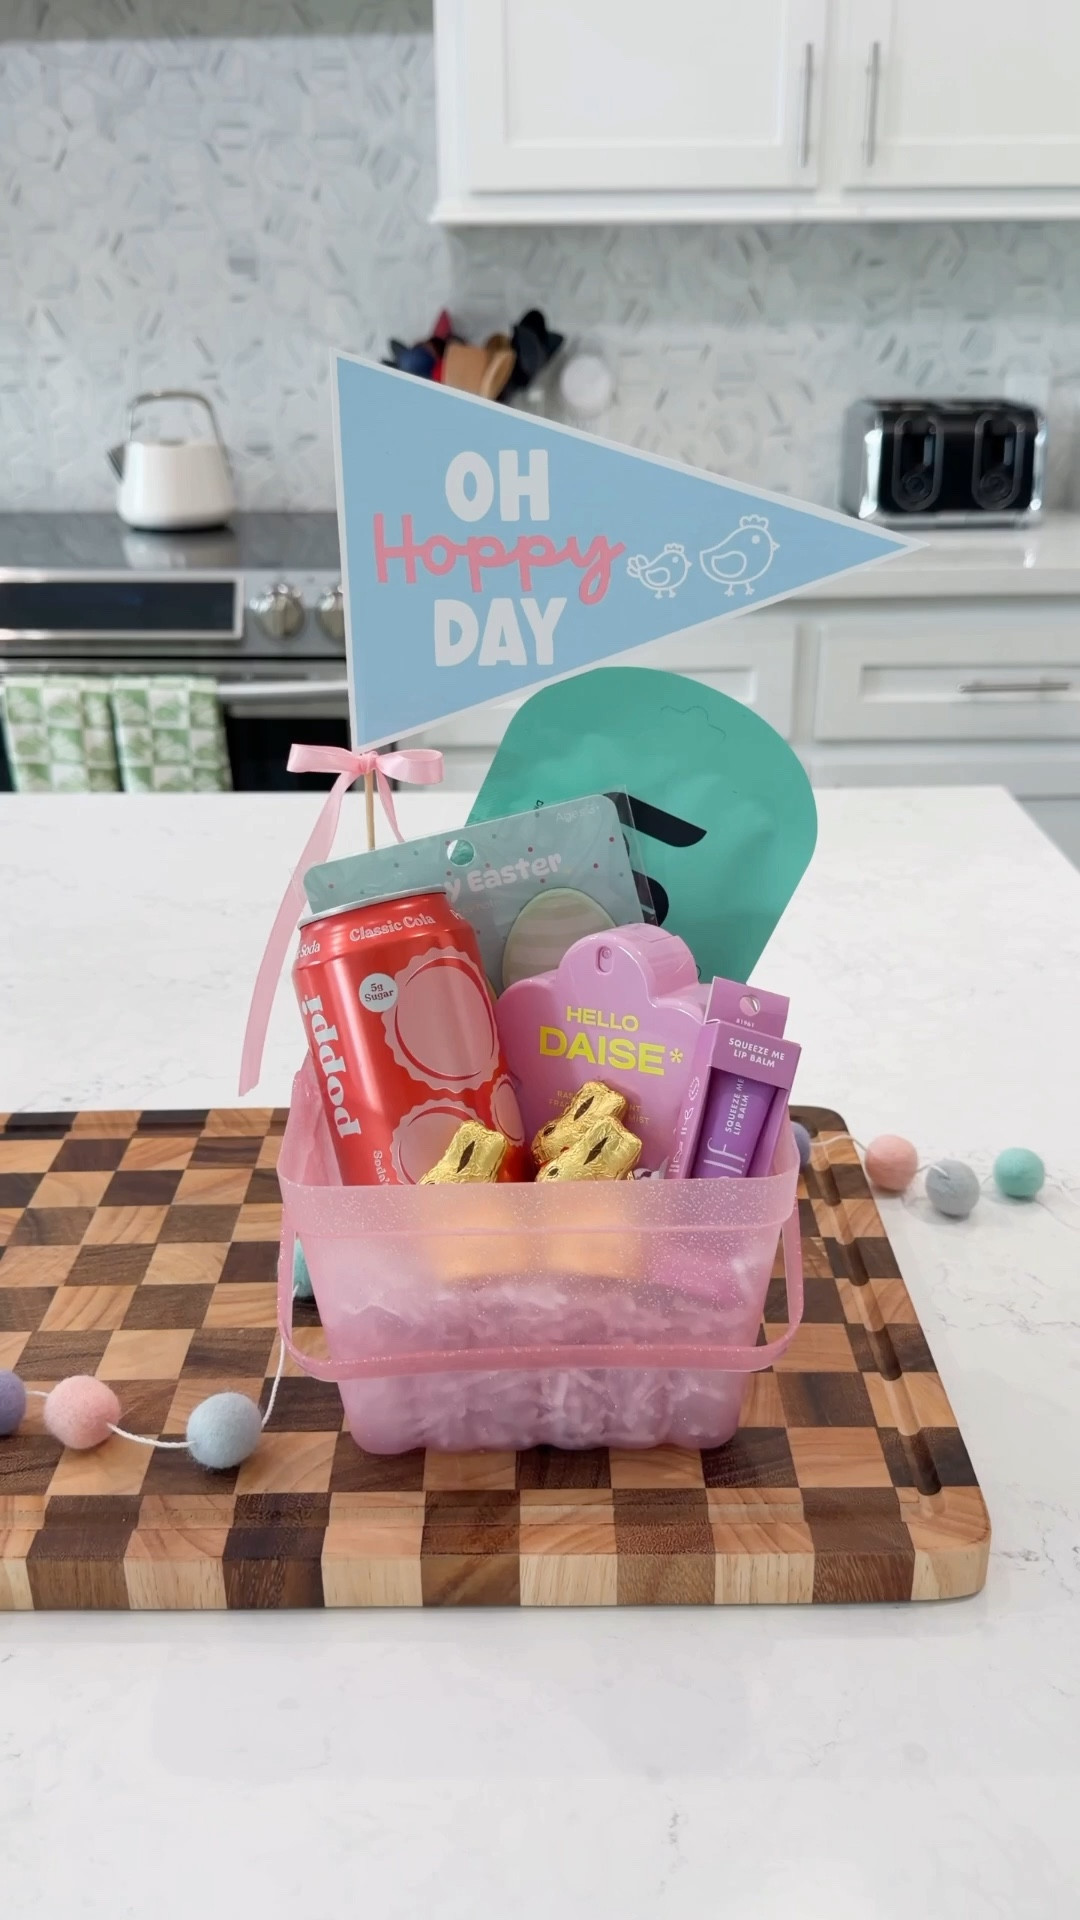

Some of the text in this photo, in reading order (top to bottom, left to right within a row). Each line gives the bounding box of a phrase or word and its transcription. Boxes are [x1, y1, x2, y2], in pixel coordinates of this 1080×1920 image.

[445, 449, 550, 522] OH
[373, 513, 626, 605] Hoppy
[433, 598, 567, 667] DAY
[467, 853, 562, 892] Easter
[349, 919, 403, 942] Classic
[403, 913, 435, 930] Cola
[364, 988, 395, 1004] Sugar
[371, 983, 384, 995] 5g
[566, 1006, 639, 1032] HELLO
[304, 994, 361, 1139] poppi
[729, 1037, 785, 1061] SQUEEZE ME
[733, 1051, 776, 1068] LIP BALM
[725, 1078, 744, 1133] SQUEEZE ME
[733, 1094, 750, 1136] LIP BALM
[372, 1150, 390, 1185] Soda'
